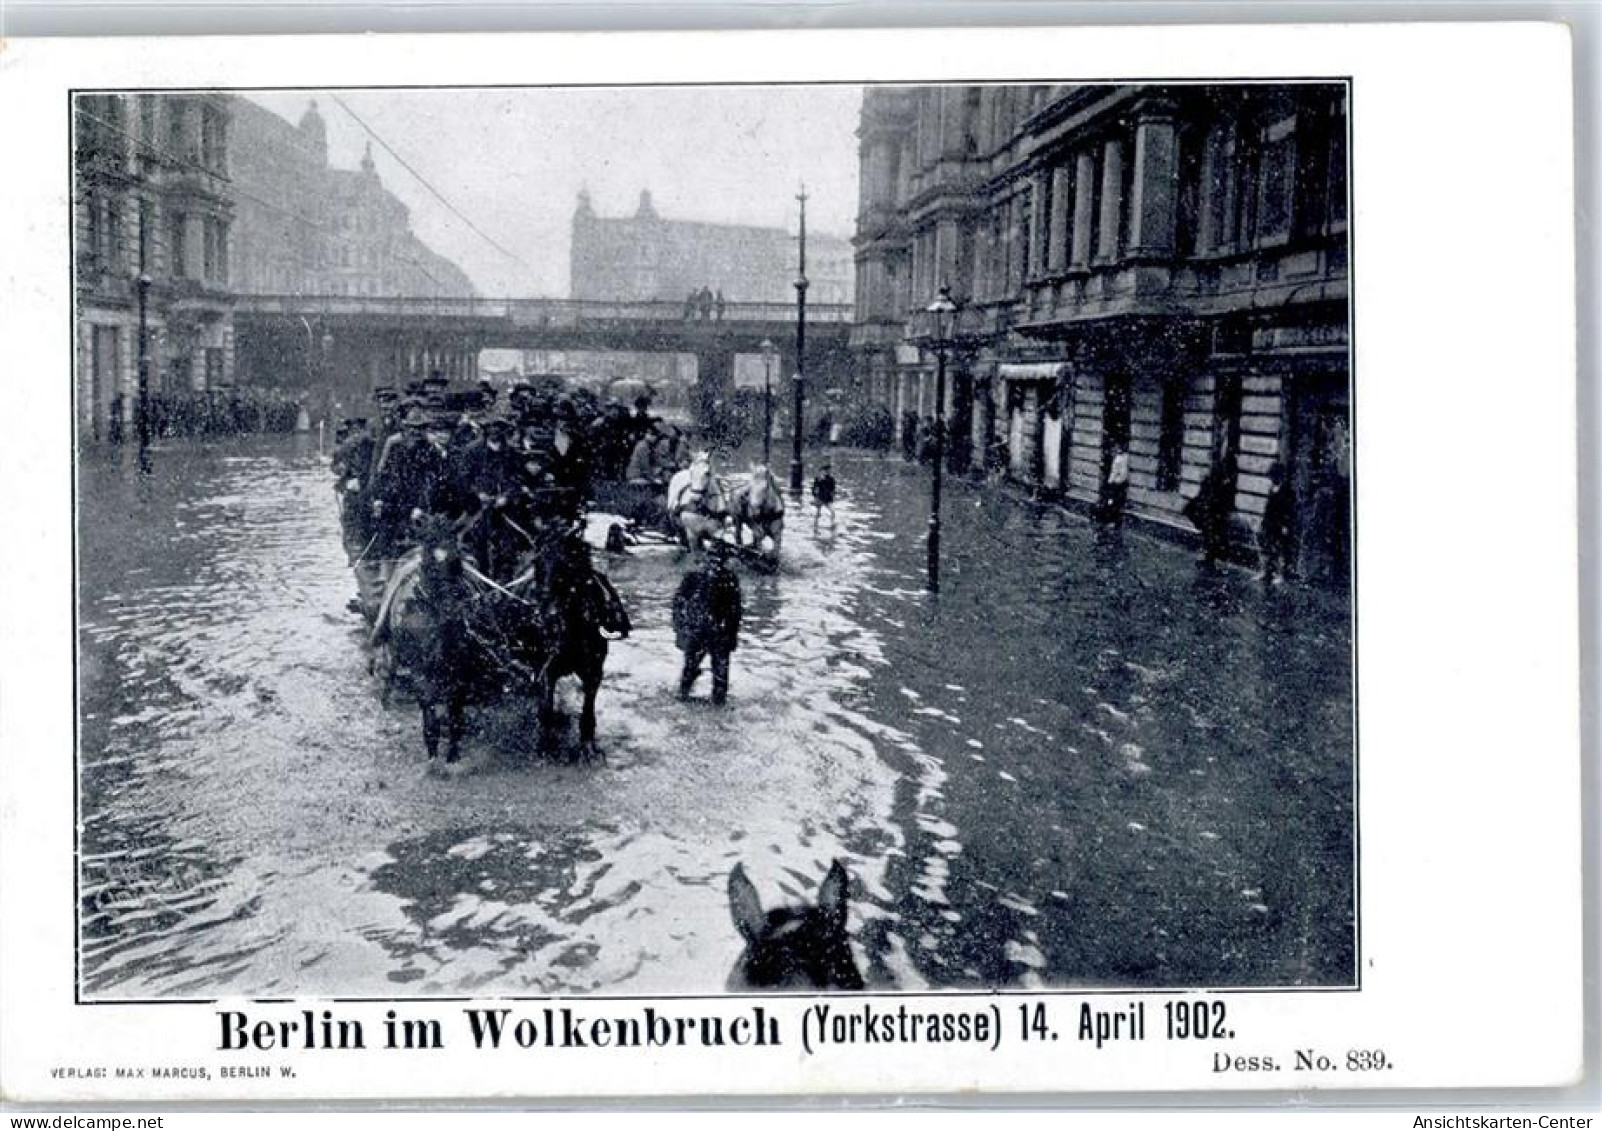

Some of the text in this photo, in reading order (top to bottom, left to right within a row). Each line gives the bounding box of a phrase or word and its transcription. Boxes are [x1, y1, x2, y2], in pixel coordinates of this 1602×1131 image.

[216, 1001, 1237, 1056] Berlin im Wolkenbruch (Yorkstrasse) 14. April 1902.
[1212, 1049, 1394, 1073] Dess. No. 839.
[50, 1066, 297, 1081] VERLAG: MAX MARCUS, BERLIN W.
